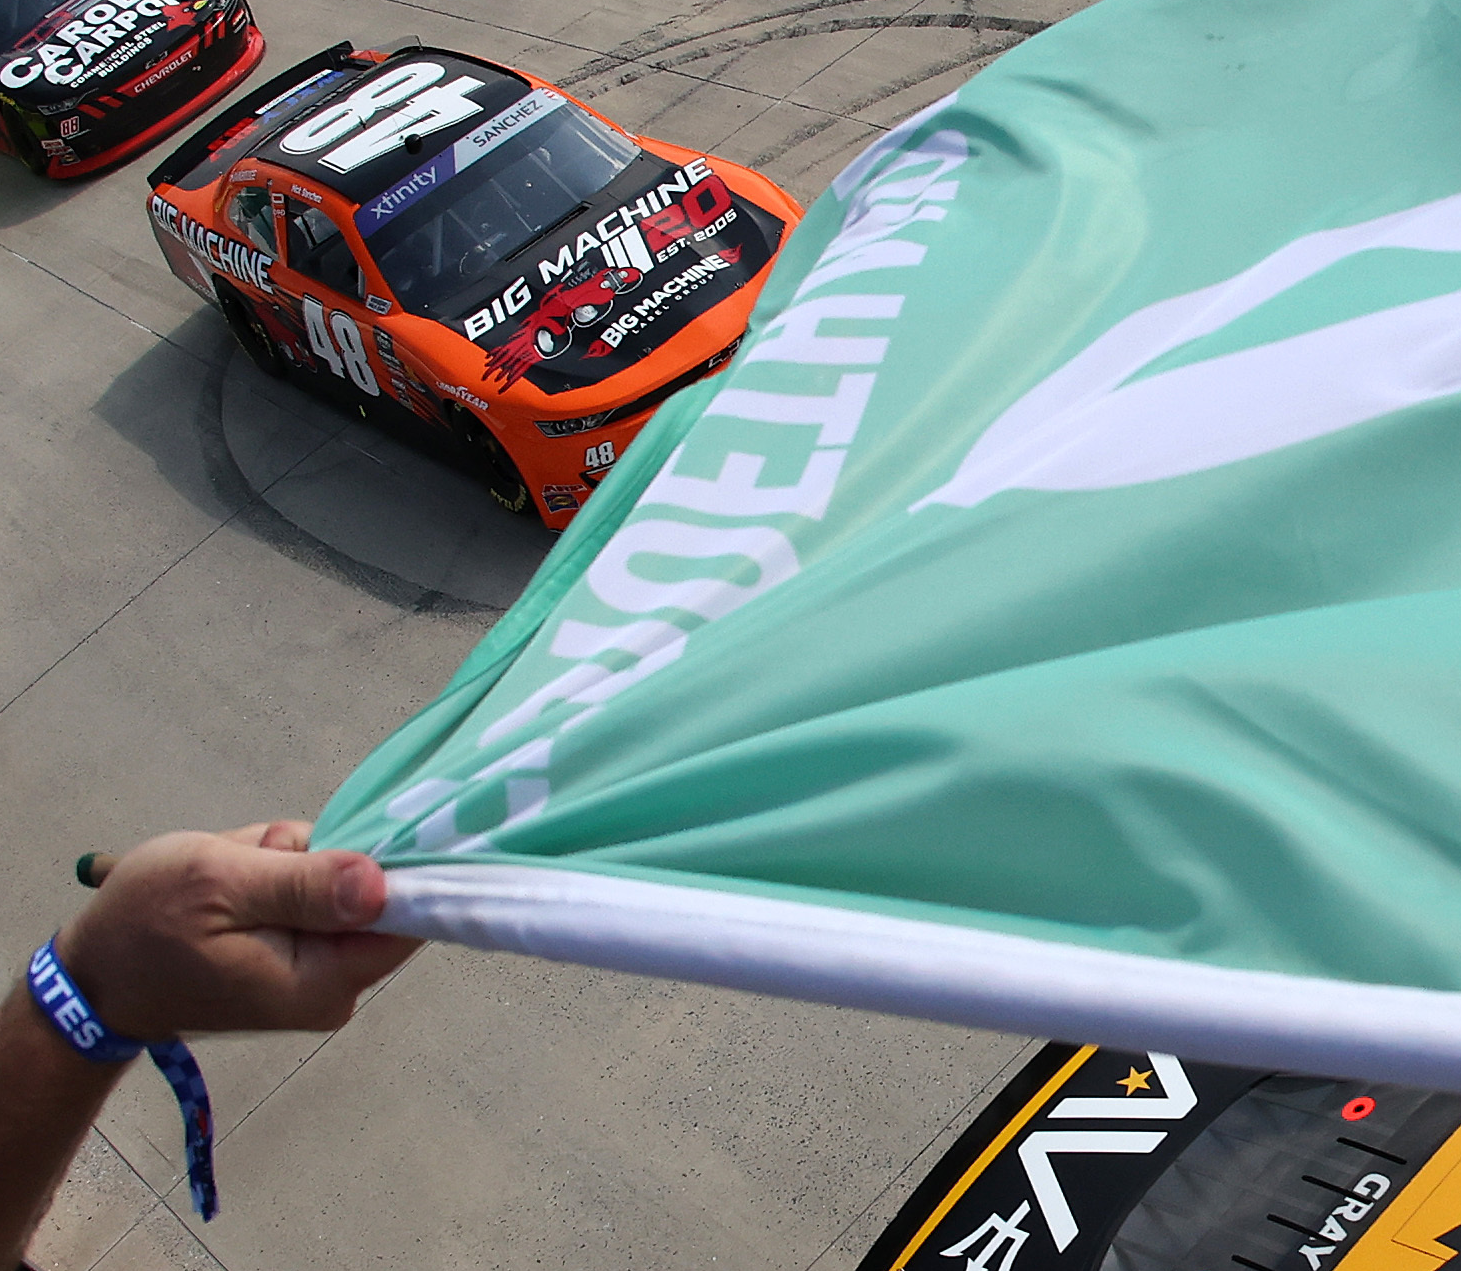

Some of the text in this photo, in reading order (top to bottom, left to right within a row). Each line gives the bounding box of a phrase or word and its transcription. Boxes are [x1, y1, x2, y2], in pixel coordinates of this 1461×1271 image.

[70, 19, 167, 90] COMMERCIAL STEEL
[97, 36, 154, 80] BUILDINGS
[133, 48, 195, 95] CHEVROLET
[472, 100, 543, 149] SANCHEZ
[369, 164, 439, 222] xfinity
[150, 194, 274, 296] BIG MACHINE
[463, 157, 714, 342] BIG MACHINE
[655, 208, 738, 265] EST. 2005
[600, 253, 732, 349] BIG MACHINE
[631, 269, 716, 336] LABEL GROUP
[302, 292, 380, 398] 48
[584, 440, 617, 469] 48
[1299, 1171, 1392, 1271] GRAY
